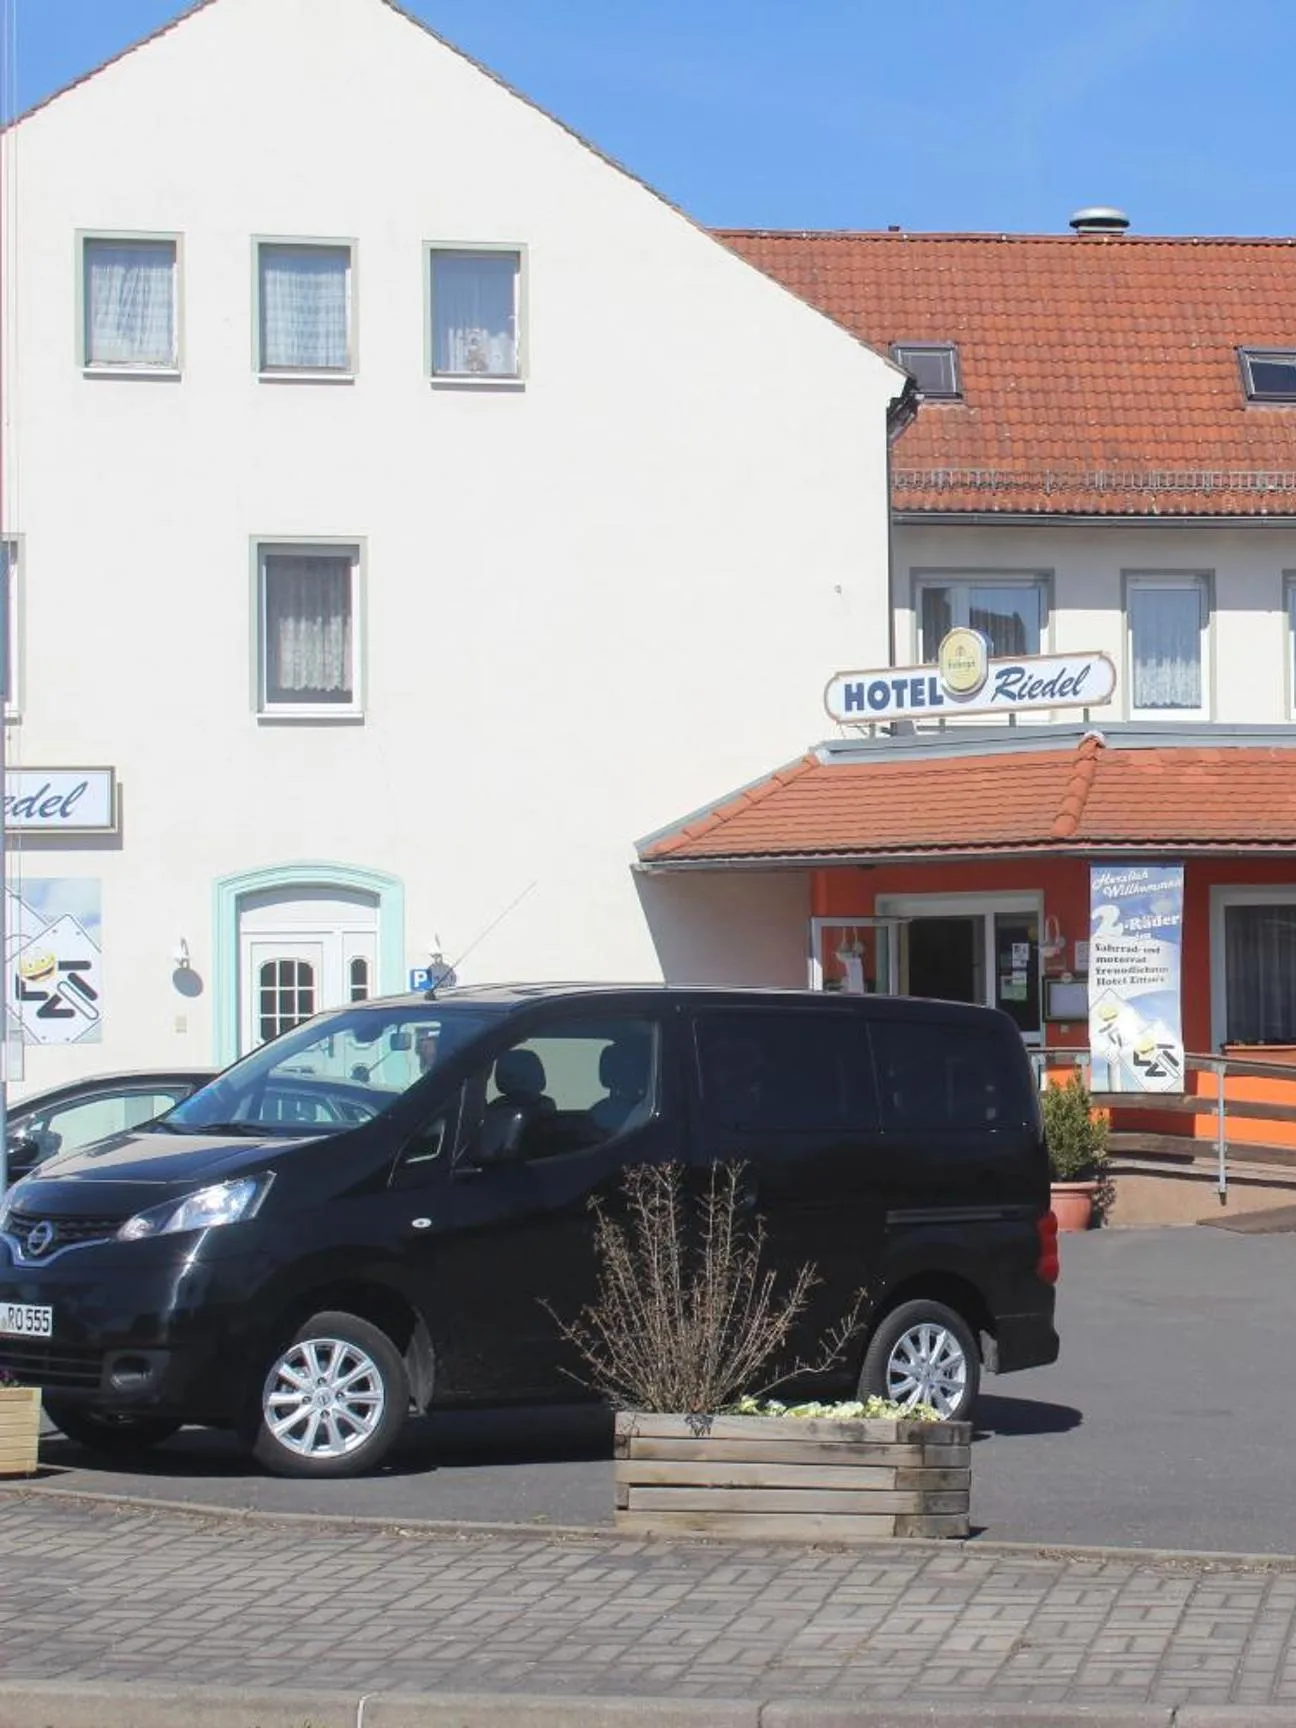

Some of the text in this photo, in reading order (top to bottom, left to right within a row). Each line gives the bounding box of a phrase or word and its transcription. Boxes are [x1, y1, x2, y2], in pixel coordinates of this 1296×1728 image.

[844, 664, 1091, 712] HOTEL Riedel
[414, 970, 428, 988] P
[26, 1308, 50, 1332] 555
